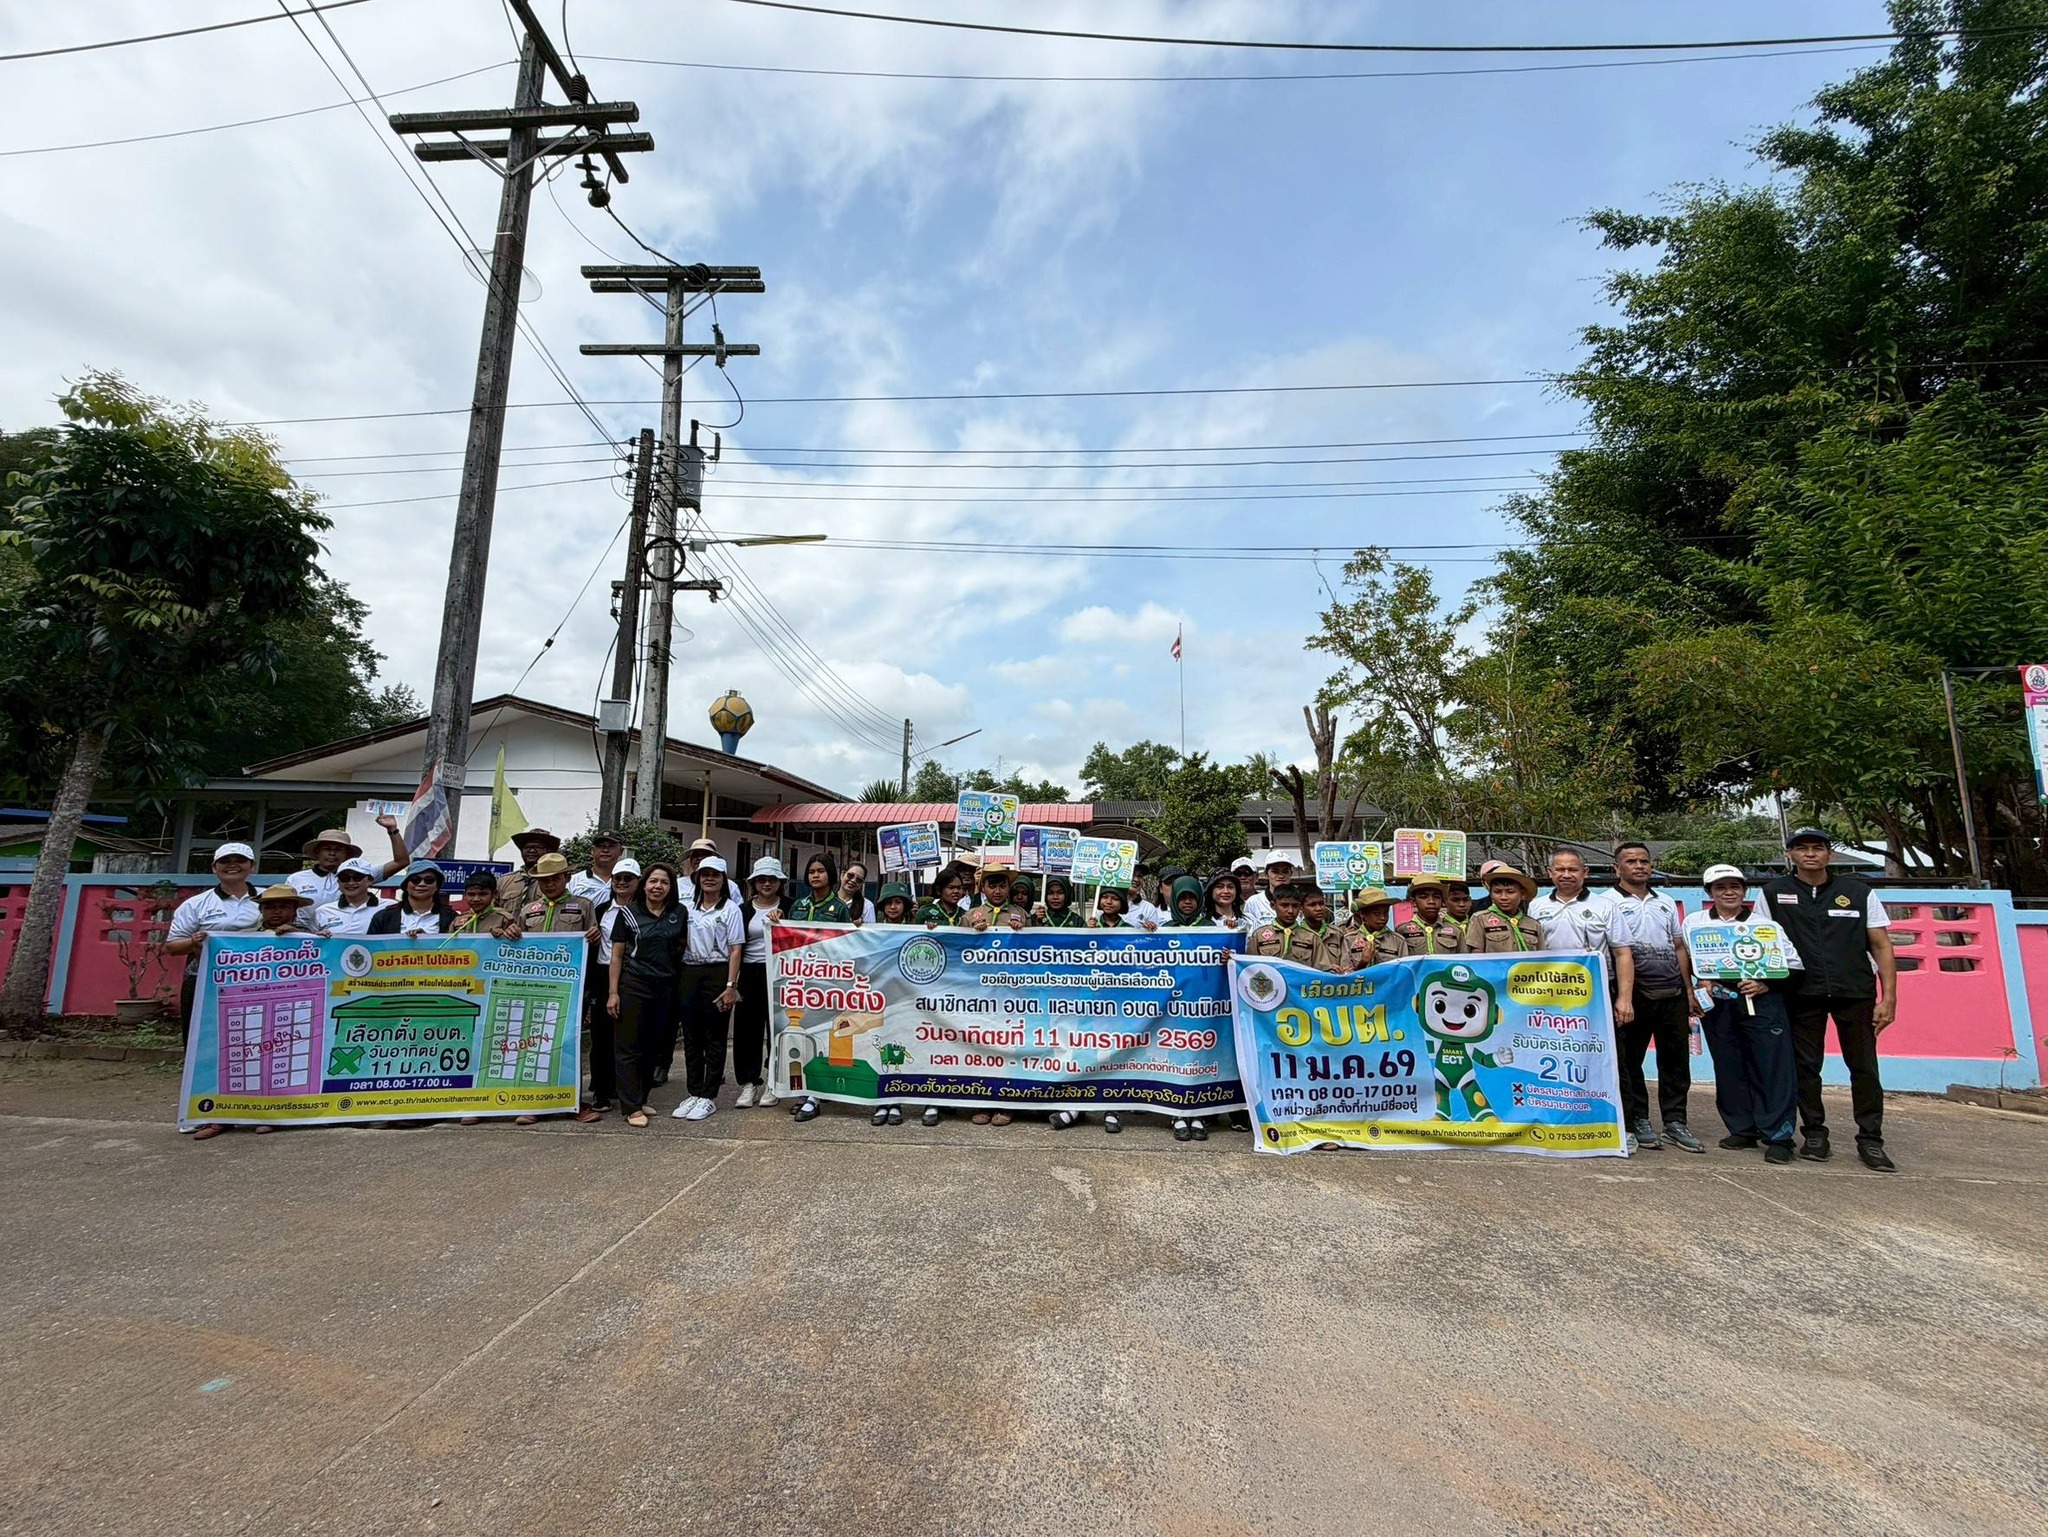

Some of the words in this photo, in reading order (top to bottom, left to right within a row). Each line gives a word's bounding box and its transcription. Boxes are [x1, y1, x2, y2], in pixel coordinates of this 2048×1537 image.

[217, 940, 319, 965] บัตรเลือกตั้ง
[376, 955, 424, 967] อย่าลืม!!
[426, 953, 470, 966] ไปใช้สิทธิ
[498, 944, 570, 963] บัตรเลือกตั้ง
[963, 941, 1223, 965] องค์การบริหารส่วนตำบลบ้านนิค
[213, 966, 271, 984] นายก
[278, 963, 331, 978] อบต.
[483, 961, 547, 976] สมาชิกสภา
[780, 952, 855, 979] ไปใช้สิทธิ
[1301, 975, 1375, 999] เลือกตั้ง
[1513, 971, 1586, 984] ออกไปใช้สิทธิ
[780, 976, 885, 1012] เลือกตั้ง
[1556, 986, 1588, 997] นะครับ
[915, 994, 997, 1013] สมาชิกสภา
[1003, 999, 1042, 1013] อบต.
[1049, 999, 1116, 1015] และนายก
[1123, 1001, 1162, 1017] อบต.
[1168, 991, 1232, 1016] บ้านนิคม
[346, 1017, 417, 1042] เลือกตั้ง
[424, 1027, 466, 1041] อบต.
[1275, 1003, 1406, 1047] อบต.
[1528, 1009, 1589, 1033] เข้าคูหา
[915, 1019, 1025, 1046] วันอาทิตย์ที่
[1034, 1028, 1060, 1046] 11
[1069, 1032, 1150, 1049] มกราคม
[1158, 1029, 1217, 1049] 2569
[1512, 1034, 1603, 1054] รับบัตรเลือกตั้ง
[369, 1043, 438, 1058] วันอาทิตย์
[371, 1061, 392, 1075] 11
[400, 1061, 436, 1074] ม.ค.
[439, 1047, 470, 1071] 69
[1441, 1055, 1465, 1065] ECT
[1442, 1048, 1463, 1056] SMART
[930, 1054, 959, 1066] เวลา
[964, 1054, 1004, 1067] 08.00
[1022, 1057, 1061, 1071] 17.00
[1067, 1061, 1081, 1072] น.
[1270, 1052, 1299, 1080] 11
[1379, 1049, 1416, 1078] 69
[1539, 1056, 1559, 1081] 2
[1564, 1059, 1588, 1083] ใบ
[350, 1081, 373, 1090] เวลา
[376, 1078, 440, 1090] 08.00-17.00
[442, 1079, 452, 1087] น.
[1271, 1087, 1304, 1100] เวลา
[1556, 1132, 1577, 1140] 7535
